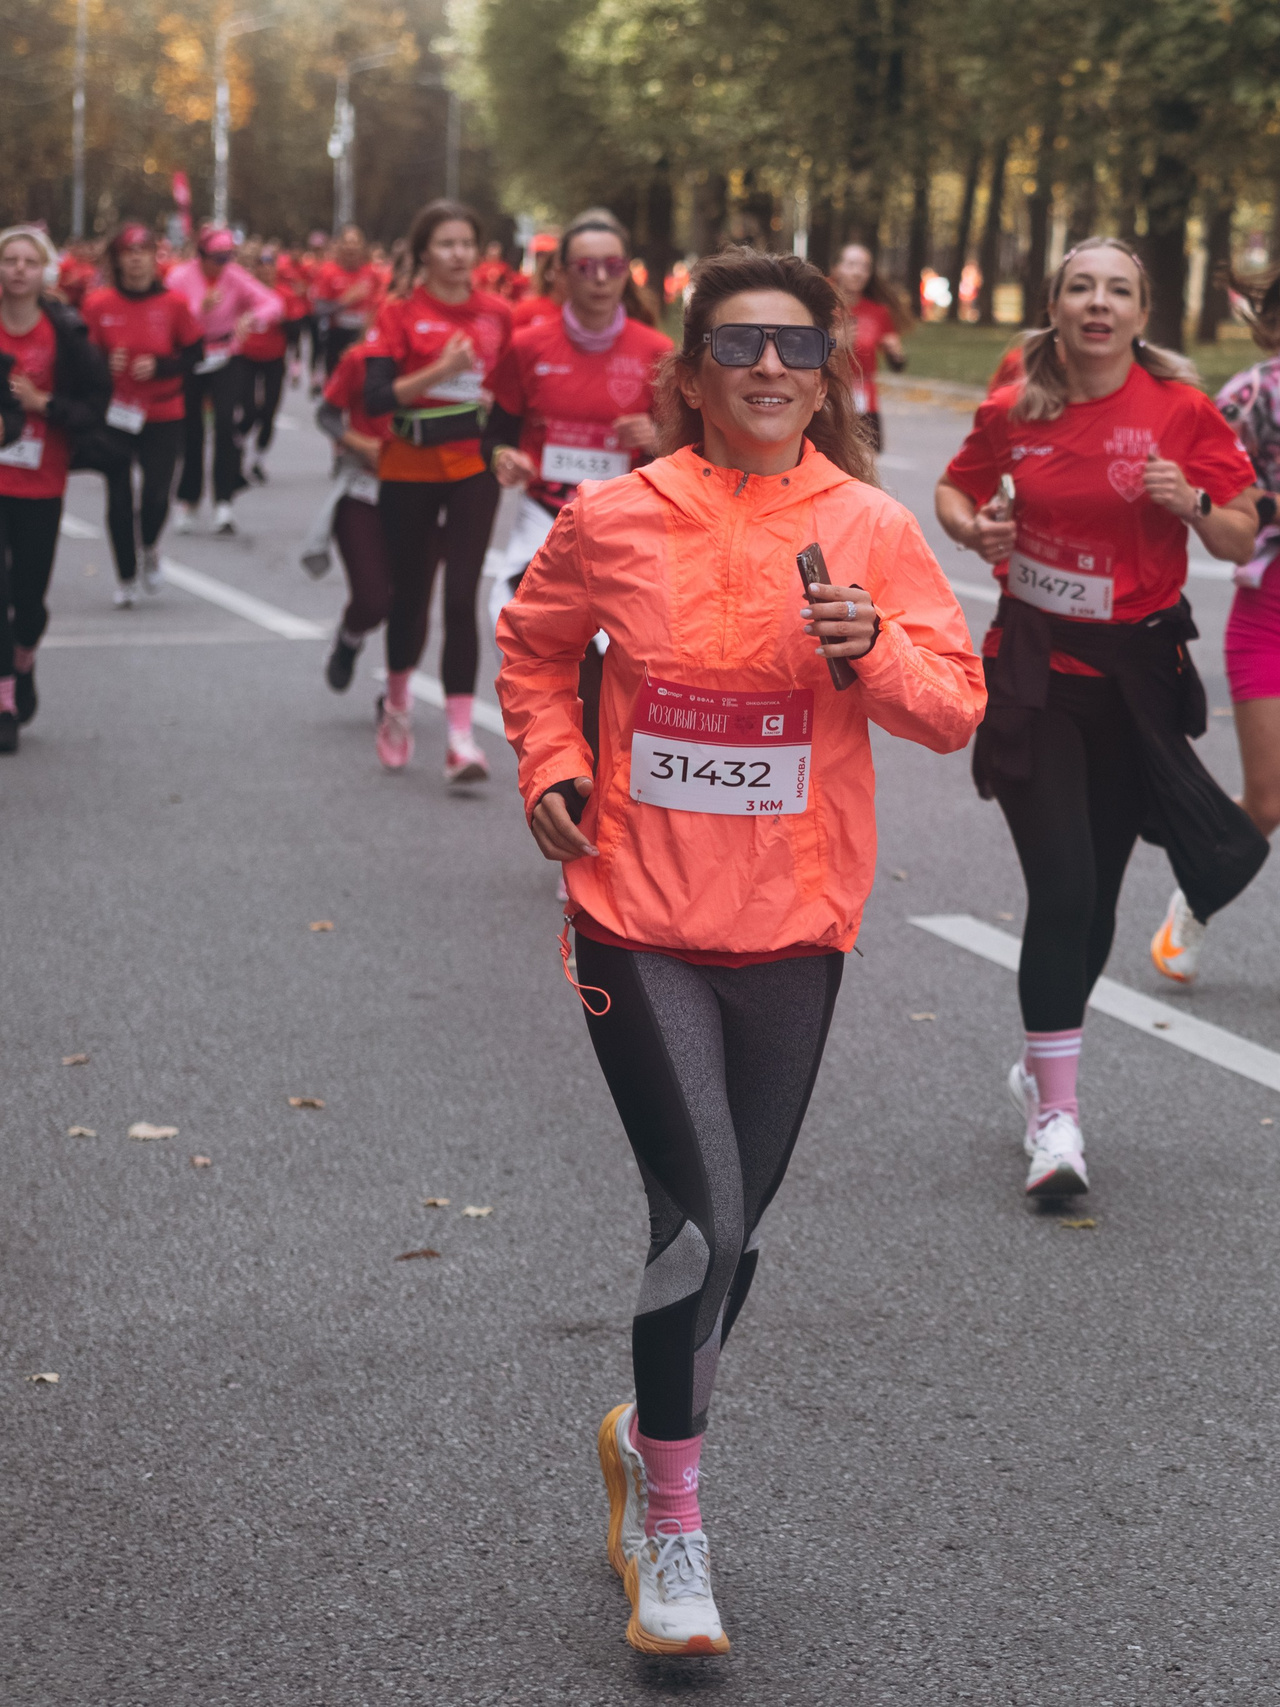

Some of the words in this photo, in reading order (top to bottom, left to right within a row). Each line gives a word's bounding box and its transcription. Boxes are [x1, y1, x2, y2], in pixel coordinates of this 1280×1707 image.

[1018, 564, 1087, 601] 31472
[648, 702, 697, 730] РОЗОВЫЙ
[698, 712, 730, 734] ЗАБЕГ
[650, 751, 771, 788] 31432
[796, 756, 806, 798] МОСКВА
[746, 800, 755, 811] 3
